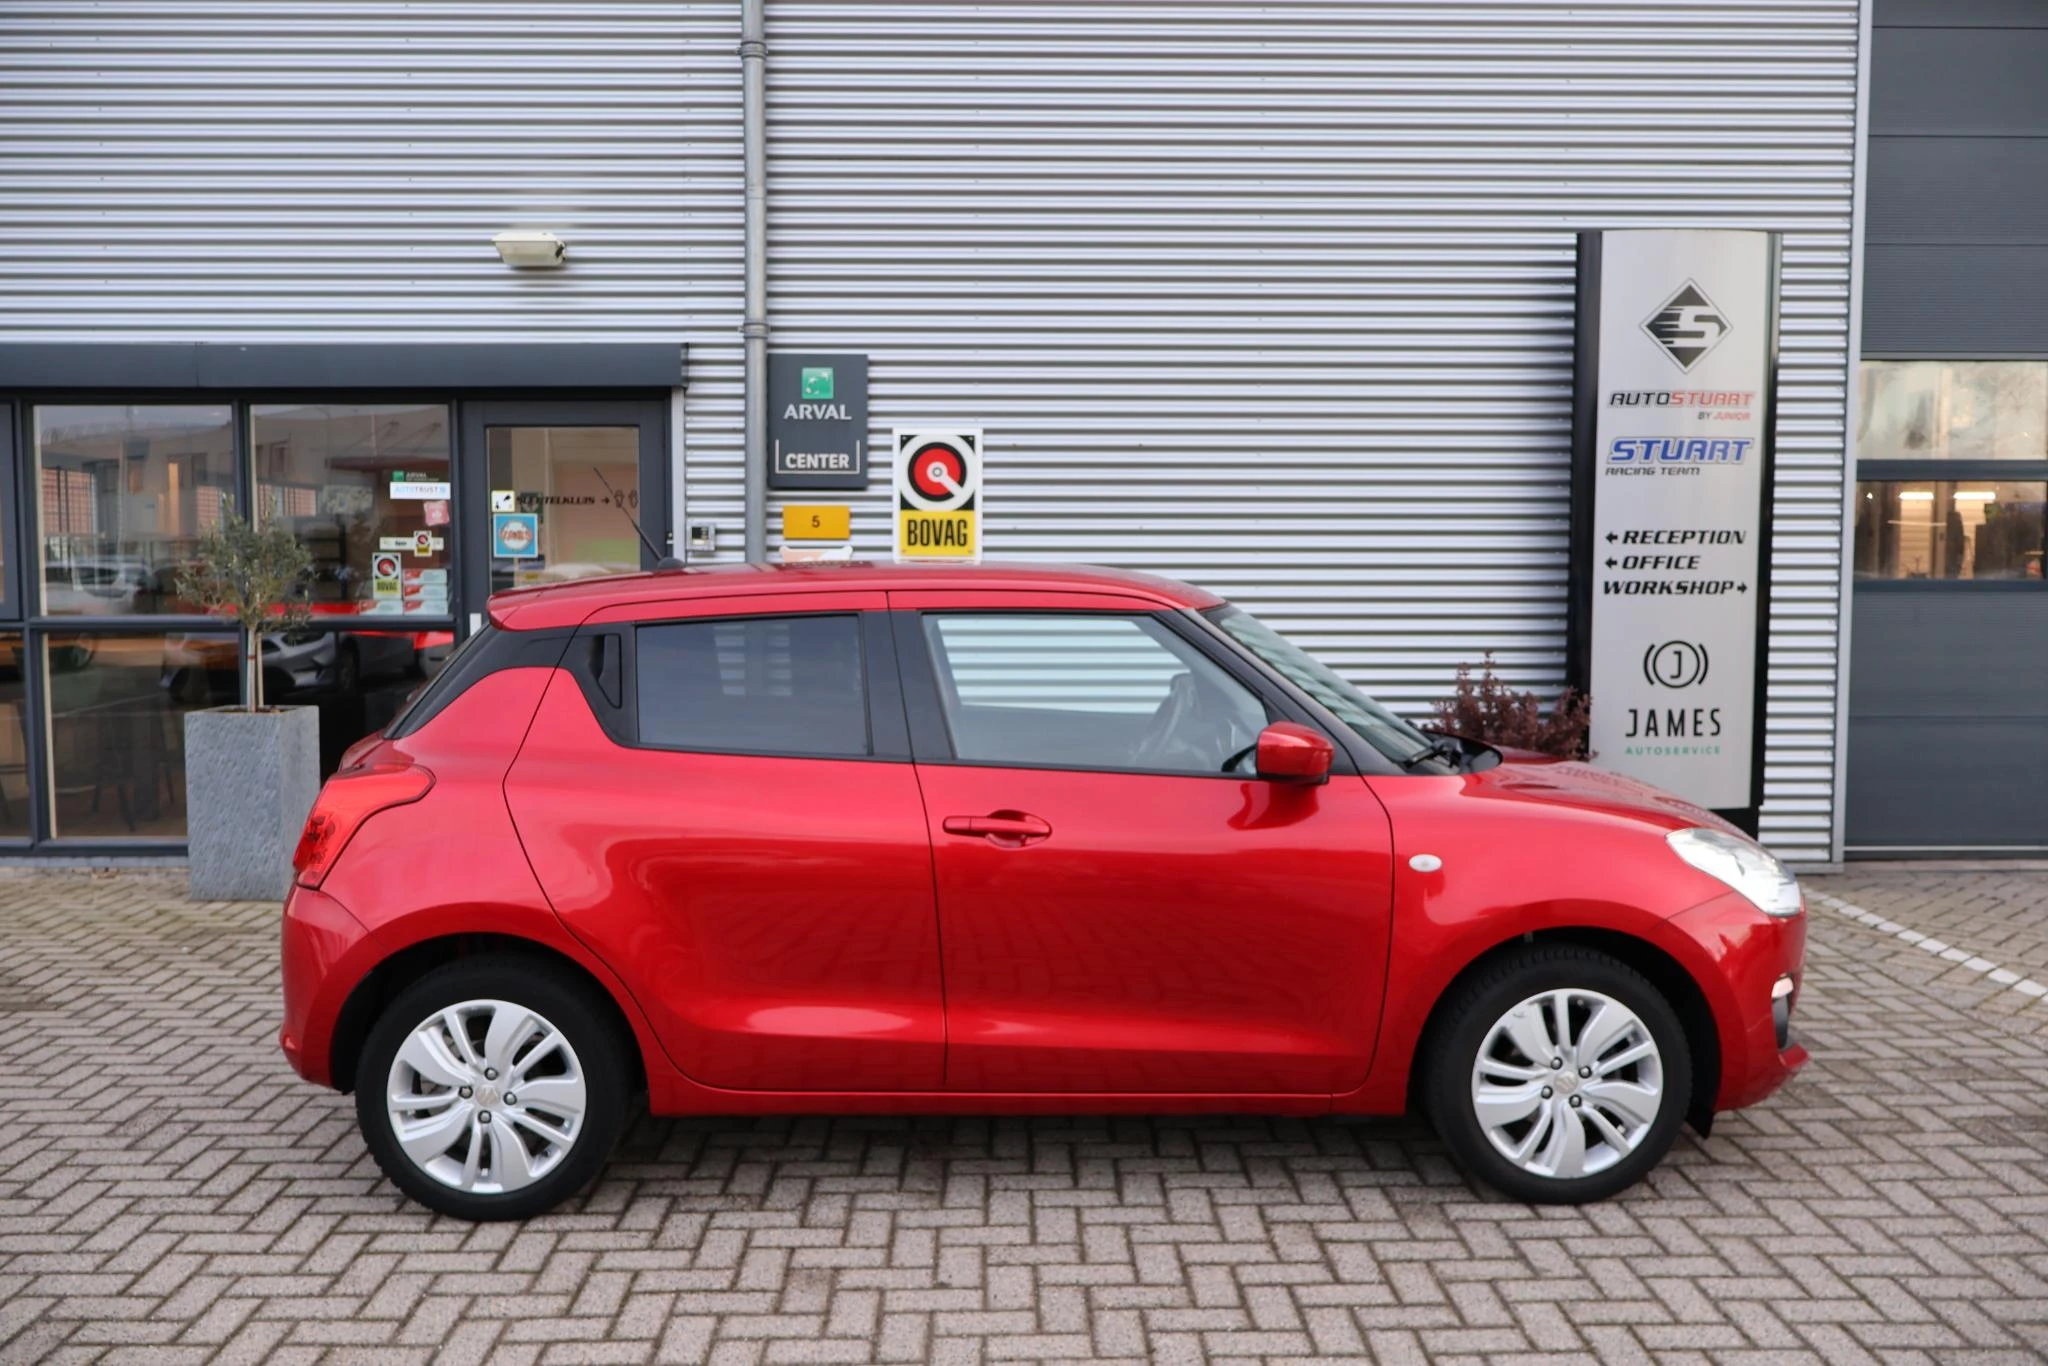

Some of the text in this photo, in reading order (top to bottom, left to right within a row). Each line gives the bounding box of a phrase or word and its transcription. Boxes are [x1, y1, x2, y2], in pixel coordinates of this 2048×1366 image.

[1610, 391, 1755, 406] AUTOSTUART
[783, 404, 852, 420] ARVAL
[1697, 411, 1710, 420] BY
[1609, 439, 1752, 462] STUART
[785, 453, 850, 469] CENTER
[1605, 466, 1700, 476] RACING TEAM
[811, 515, 821, 528] 5
[907, 518, 968, 547] BOVAG
[1622, 530, 1746, 545] RECEPTION
[1622, 555, 1700, 570] OFFICE
[1603, 580, 1735, 595] WORKSHOP
[1625, 708, 1721, 738] JAMES
[1625, 745, 1721, 756] AUTOSERVICE
